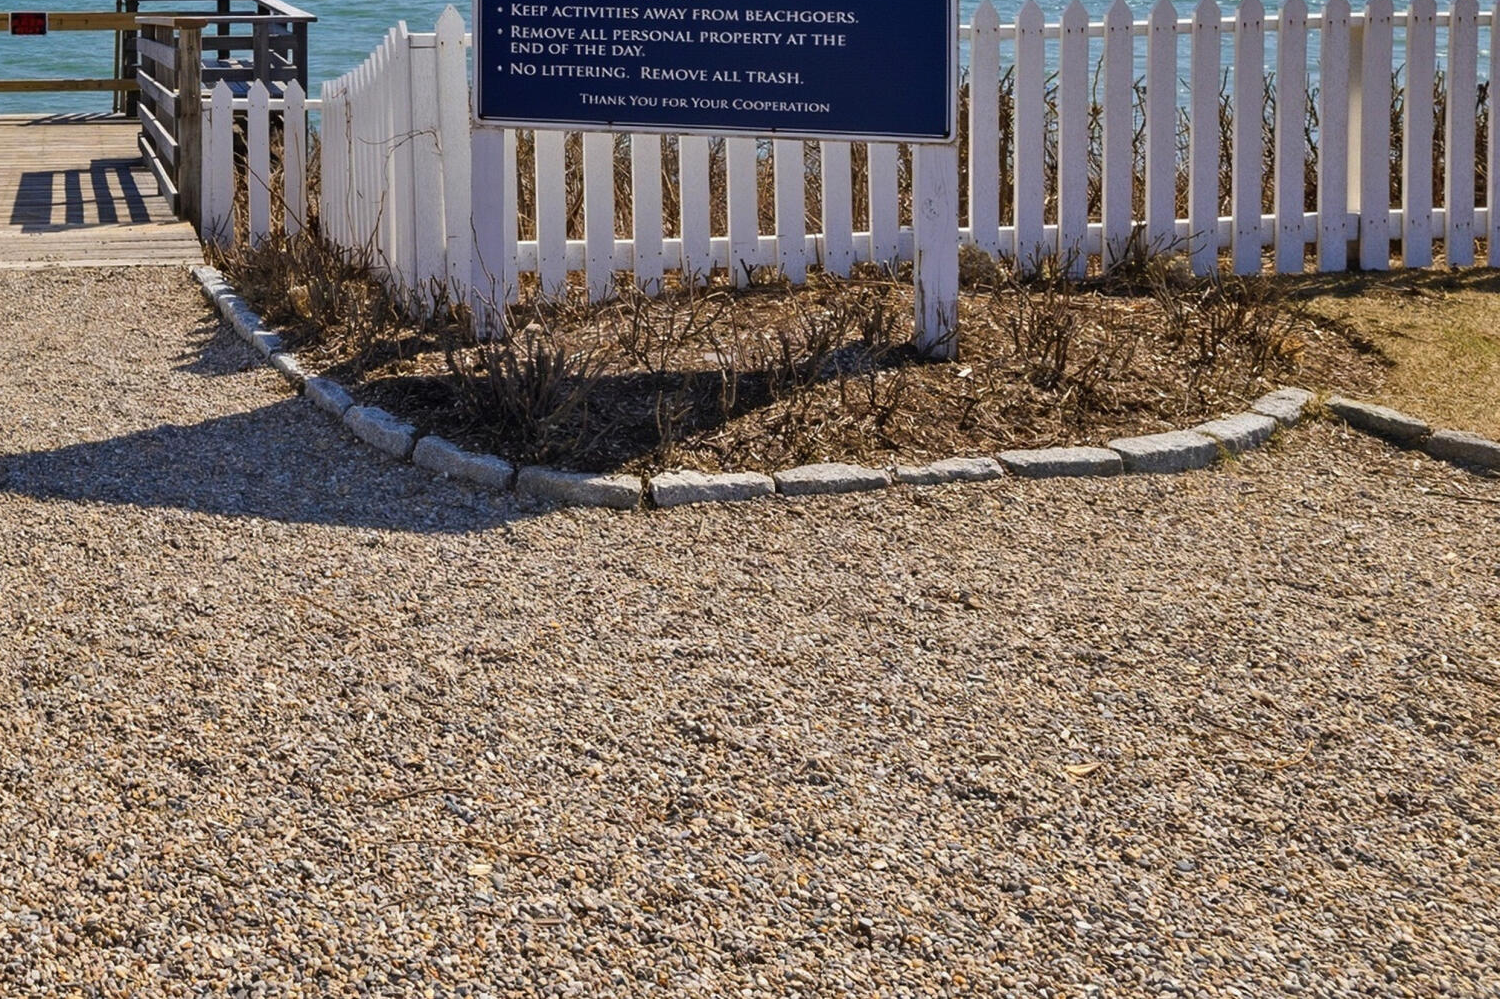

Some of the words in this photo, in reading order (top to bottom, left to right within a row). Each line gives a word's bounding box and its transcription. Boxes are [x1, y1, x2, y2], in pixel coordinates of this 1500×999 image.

[511, 3, 548, 17] KEEP
[551, 5, 640, 20] ACTIVITIES
[643, 7, 688, 20] AWAY
[692, 8, 740, 22] FROM
[745, 9, 859, 24] BEACHGOERS.
[511, 25, 576, 40] REMOVE
[579, 28, 608, 41] ALL
[613, 29, 694, 43] PERSONAL
[699, 31, 783, 45] PROPERTY
[786, 33, 808, 46] AT
[810, 33, 846, 47] THE
[510, 41, 544, 54] END
[548, 43, 569, 55] OF
[573, 43, 606, 56] THE
[611, 44, 646, 57] DAY.
[510, 62, 537, 76] NO
[542, 64, 630, 79] LITTERING.
[640, 66, 708, 82] REMOVE
[711, 70, 742, 83] ALL
[745, 70, 804, 85] TRASH.
[579, 92, 627, 106] THANK
[628, 95, 658, 107] YOU
[662, 97, 689, 108] FOR
[690, 97, 729, 110] YOUR
[731, 98, 830, 113] COOPERATION
